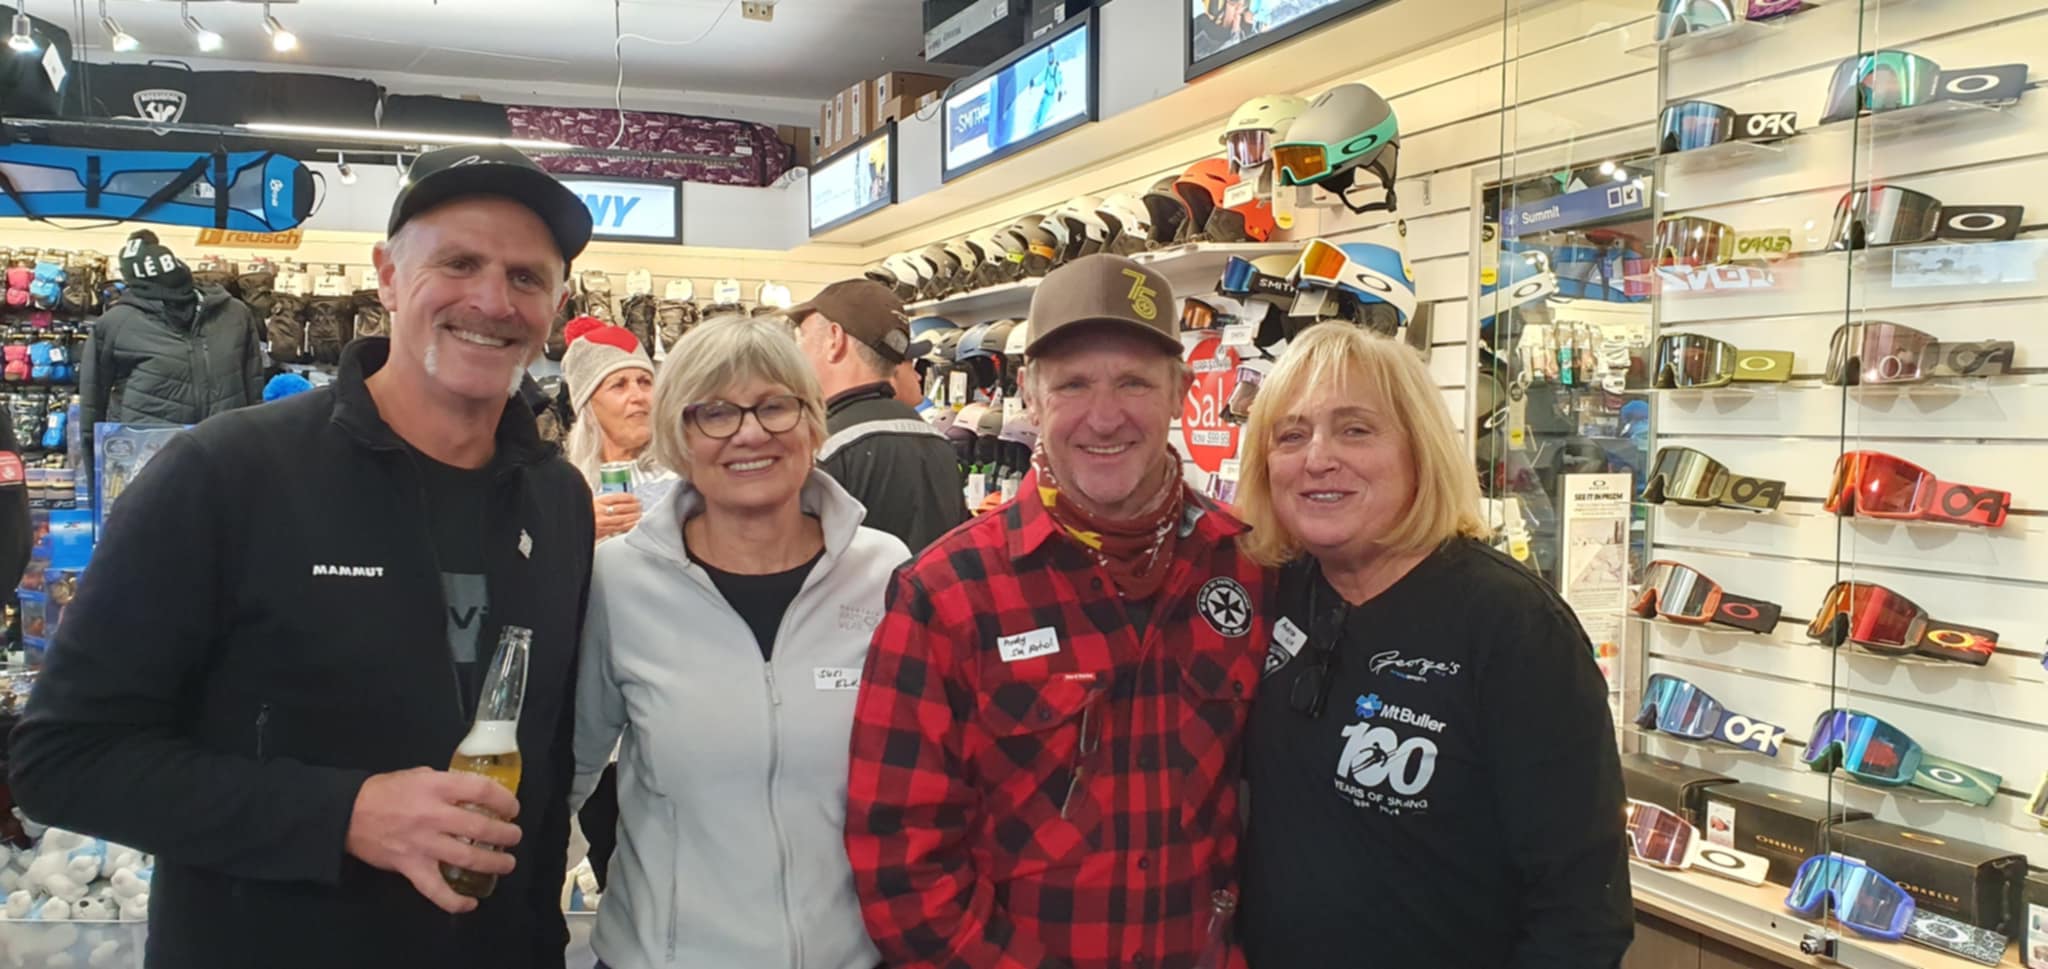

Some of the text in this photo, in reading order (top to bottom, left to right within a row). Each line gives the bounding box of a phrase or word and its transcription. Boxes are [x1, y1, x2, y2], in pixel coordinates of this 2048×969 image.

[1746, 113, 1796, 136] OAK
[577, 193, 641, 227] NY
[1522, 205, 1560, 225] Summit
[226, 231, 299, 244] reusch
[132, 253, 183, 278] LÉ B
[1187, 377, 1236, 428] Sal
[312, 564, 384, 577] MAMMUT
[1369, 650, 1461, 675] George's
[1337, 721, 1438, 795] 100
[1334, 778, 1365, 799] YEARS
[1367, 792, 1384, 802] OF
[1755, 834, 1805, 854] OAKLEY
[1895, 880, 1960, 904] OAKLEY
